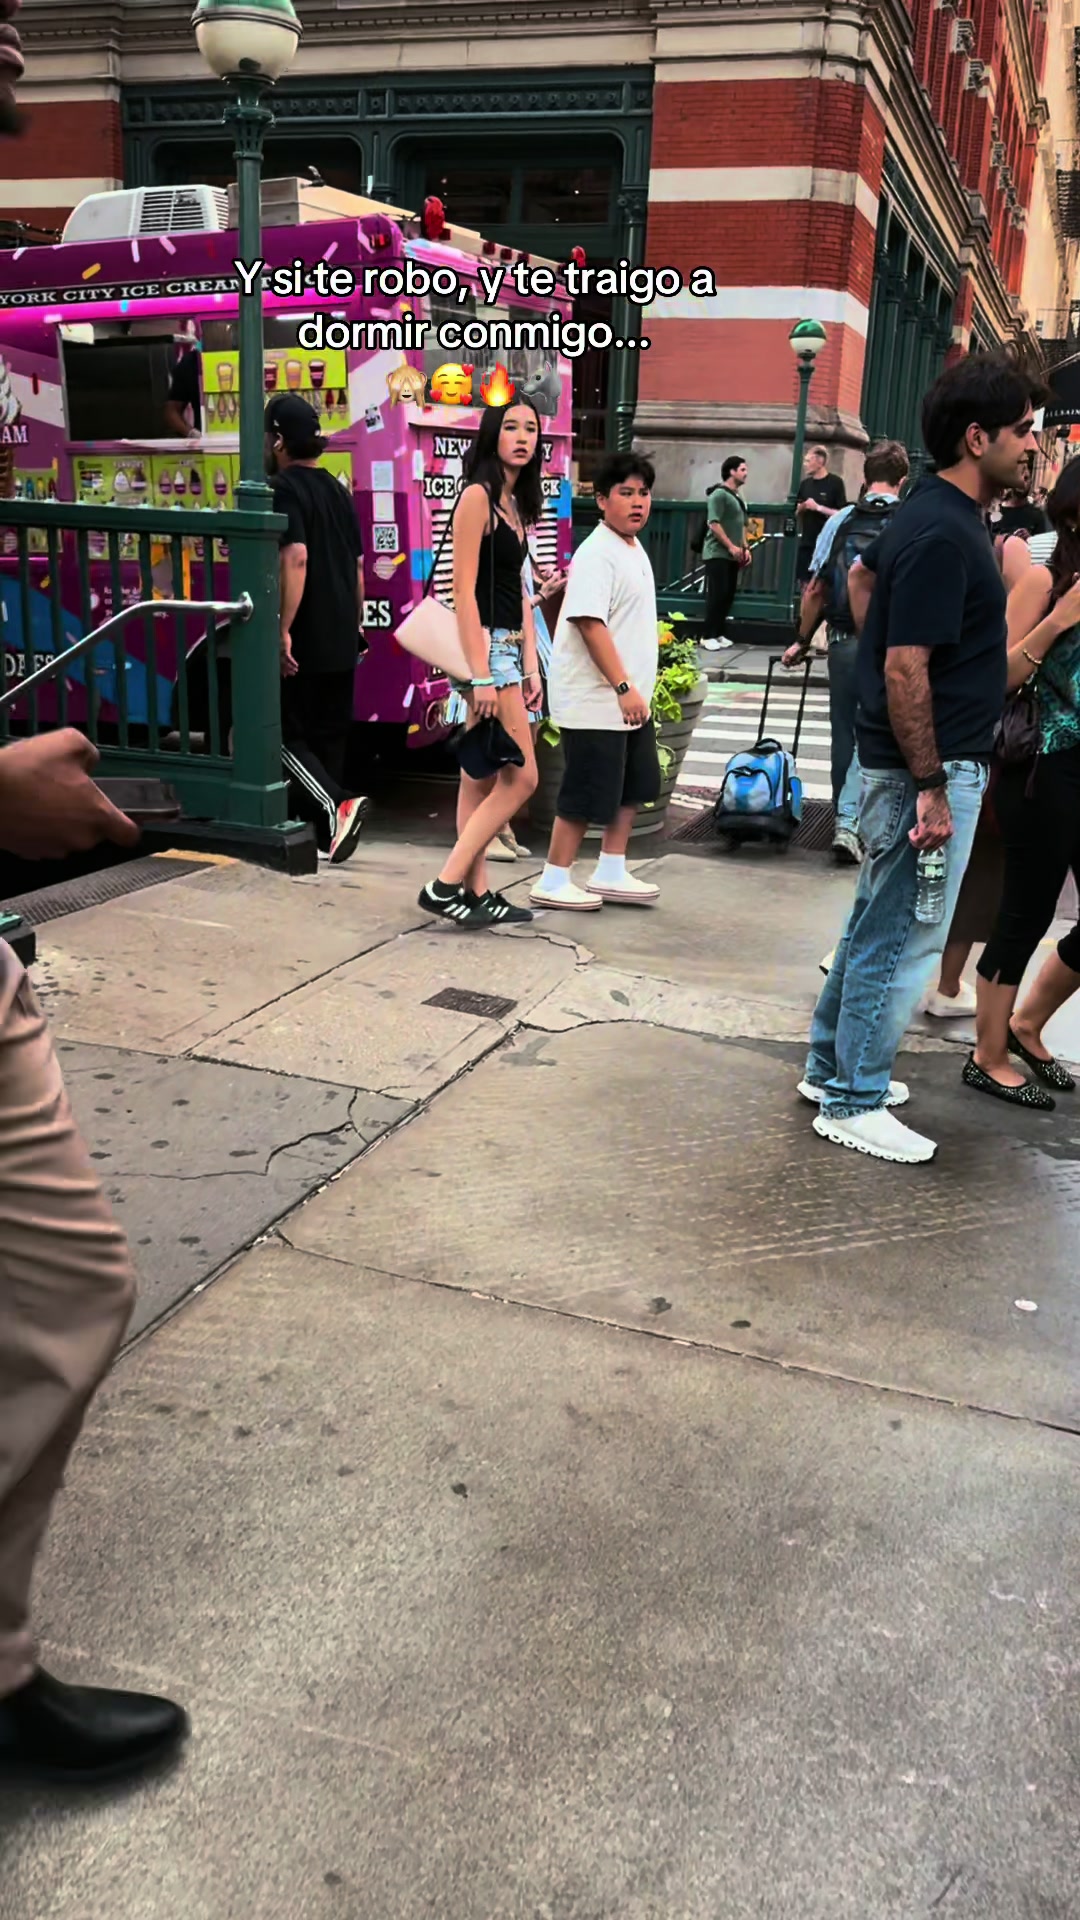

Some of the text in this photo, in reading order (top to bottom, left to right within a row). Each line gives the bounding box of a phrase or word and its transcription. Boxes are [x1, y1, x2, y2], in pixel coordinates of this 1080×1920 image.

[63, 288, 115, 301] CITY
[121, 284, 160, 298] ICE
[435, 436, 473, 457] NEW
[424, 478, 452, 497] ICE
